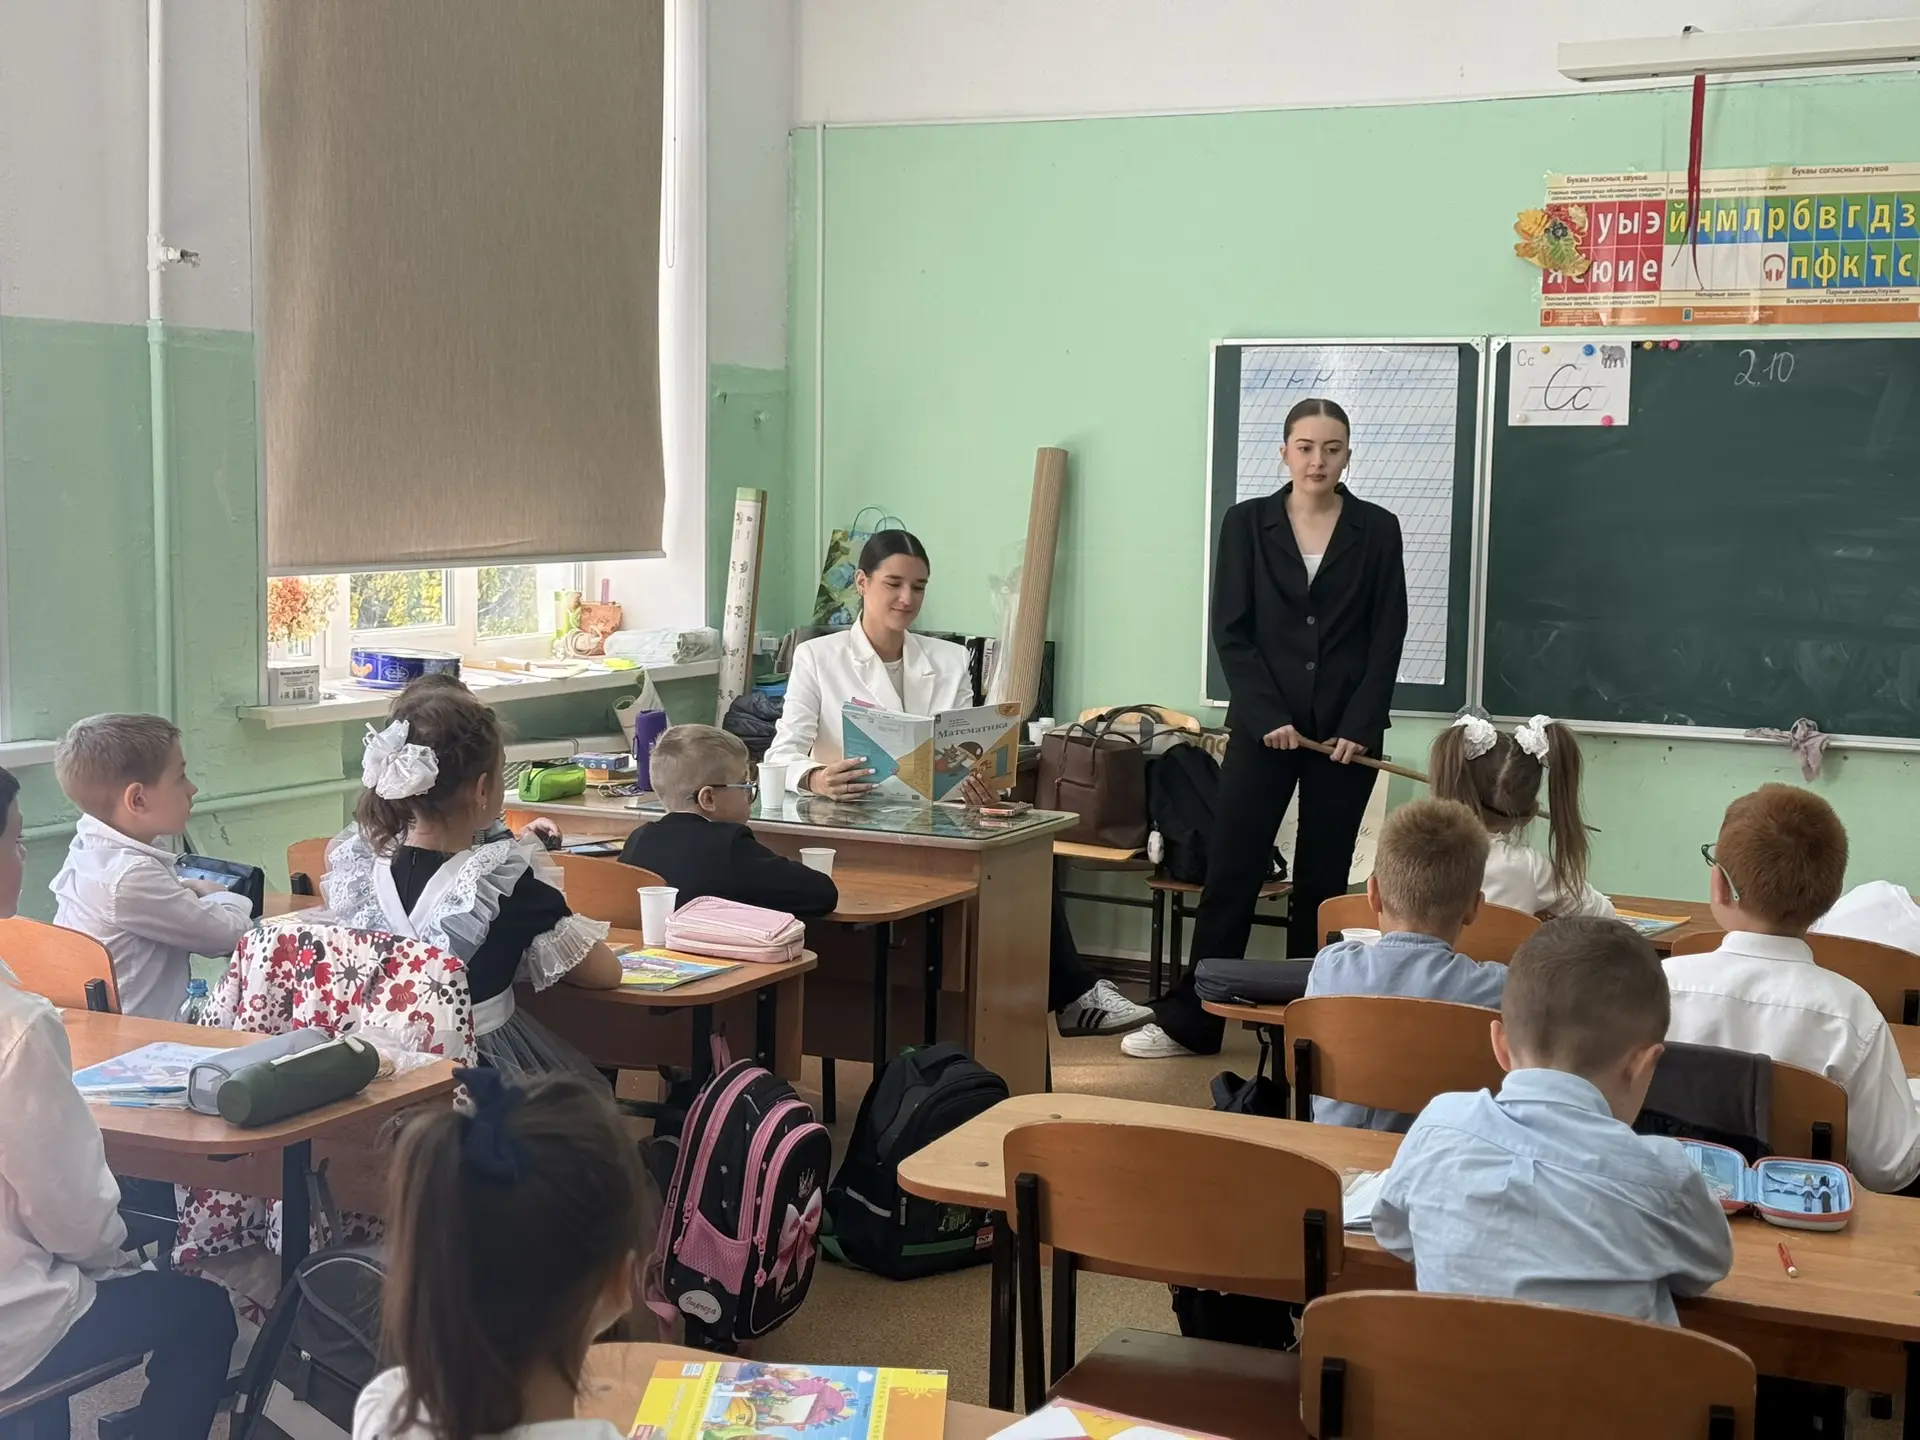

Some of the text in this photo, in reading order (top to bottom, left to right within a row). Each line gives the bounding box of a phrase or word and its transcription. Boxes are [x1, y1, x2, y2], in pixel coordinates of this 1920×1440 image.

[1567, 176, 1589, 184] Буквы
[1623, 174, 1647, 182] звуков
[1792, 165, 1889, 175] Буквы согласных звуков
[1597, 211, 1661, 243] у ы э
[1670, 198, 1915, 239] й н м л р б в г д з
[1592, 261, 1613, 283] ю
[1618, 260, 1635, 282] и
[1642, 259, 1659, 282] е
[1791, 248, 1913, 287] п ф к т с
[1734, 349, 1795, 386] 2.10
[938, 722, 1008, 739] Математика
[685, 1296, 717, 1316] Impreza
